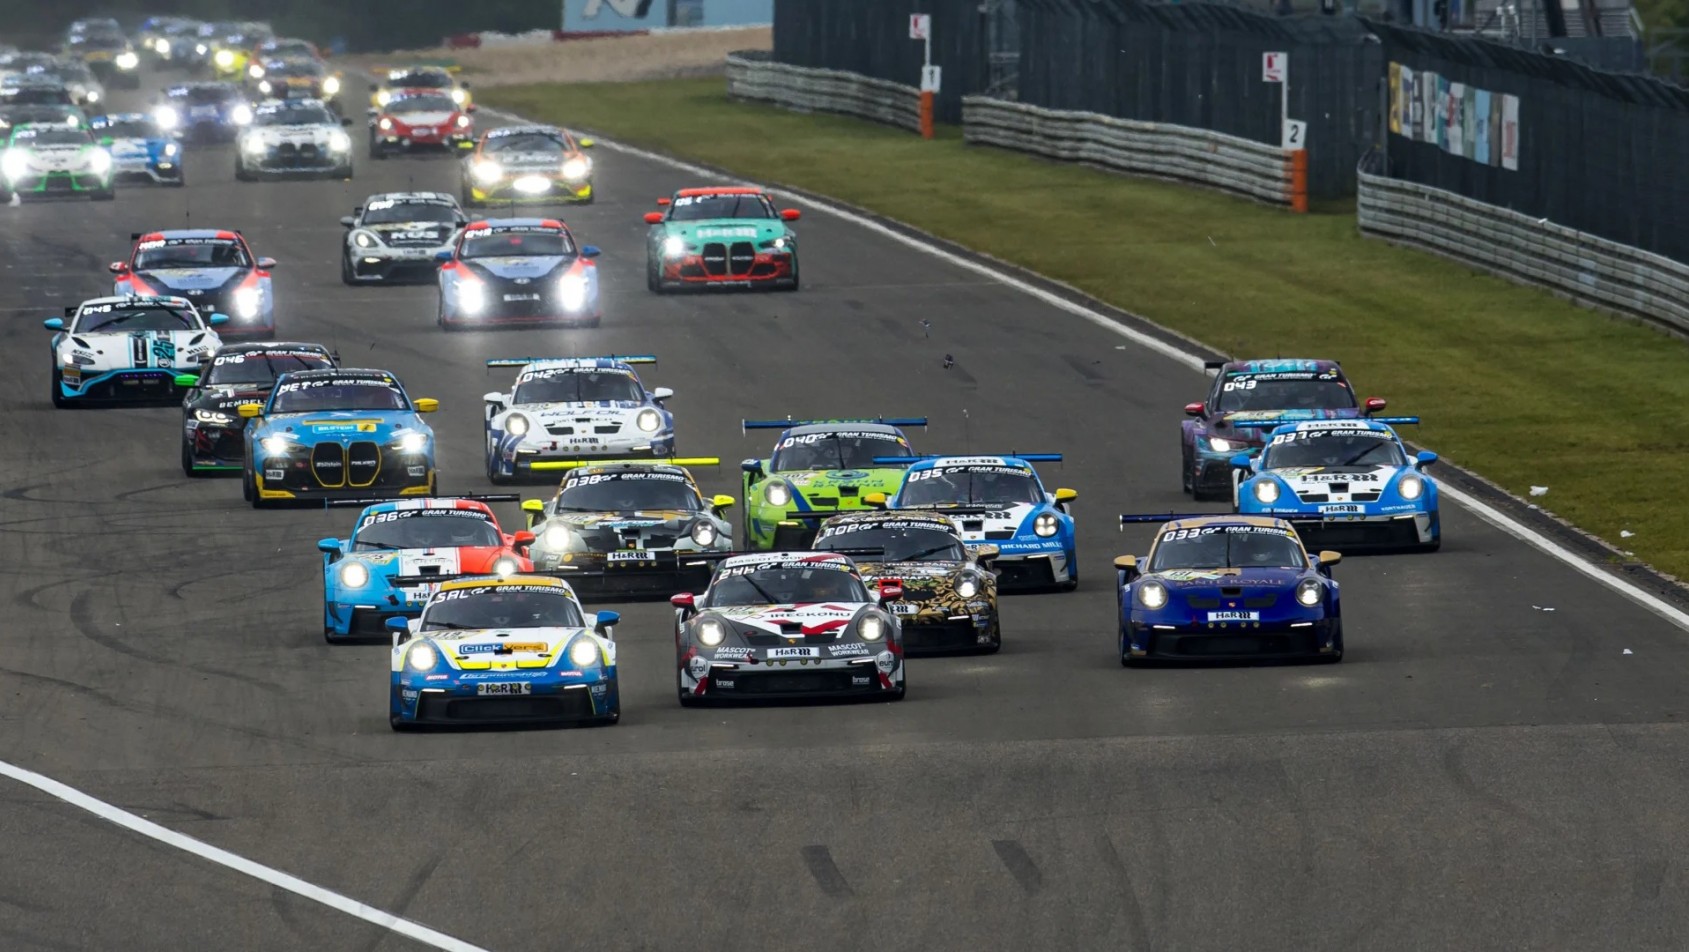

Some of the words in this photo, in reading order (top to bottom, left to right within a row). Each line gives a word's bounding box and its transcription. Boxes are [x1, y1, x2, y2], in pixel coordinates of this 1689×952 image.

[1290, 125, 1299, 143] 2
[214, 355, 245, 366] 046
[523, 370, 554, 382] 042
[280, 382, 311, 392] MET
[1224, 380, 1257, 391] 043
[783, 434, 816, 447] 040
[1273, 431, 1308, 444] 037
[1355, 430, 1393, 440] TURISMO
[908, 468, 943, 482] 035
[994, 467, 1032, 477] TURISMO
[566, 474, 601, 488] 038
[363, 511, 398, 526] 036
[449, 510, 487, 519] TURISMO
[825, 523, 859, 537] TOP
[909, 522, 949, 531] TURISMO
[1253, 527, 1294, 536] TURISM
[1163, 528, 1201, 542] 033
[524, 585, 565, 593] TURISMO
[436, 590, 469, 603] SAL
[828, 643, 863, 651] MASCOT
